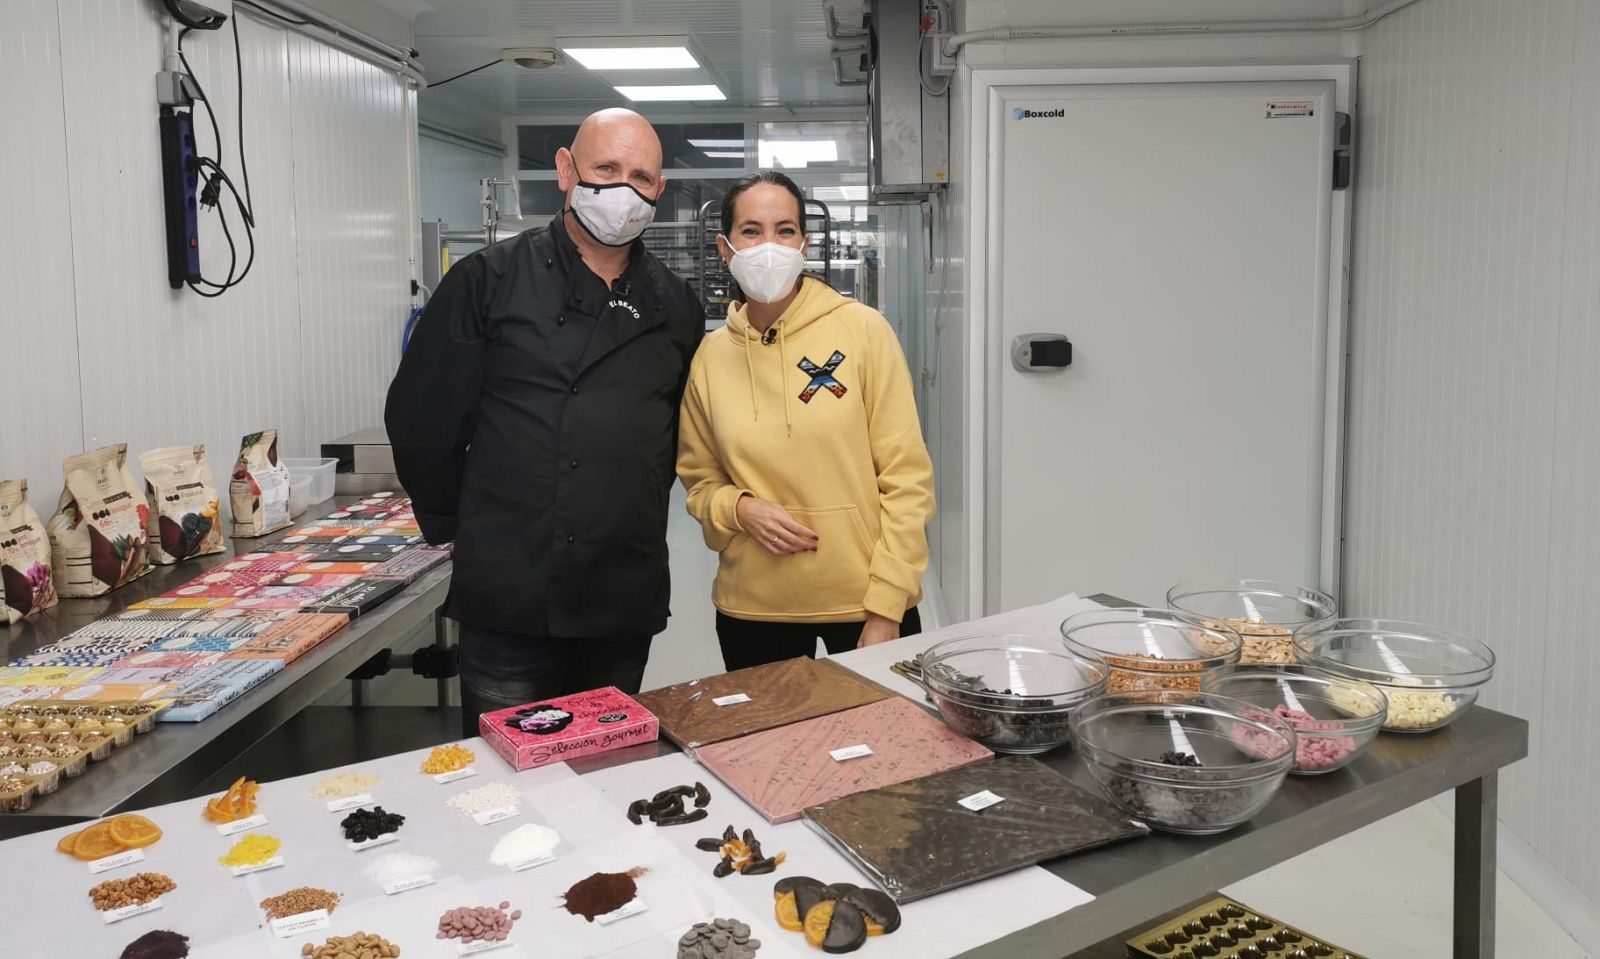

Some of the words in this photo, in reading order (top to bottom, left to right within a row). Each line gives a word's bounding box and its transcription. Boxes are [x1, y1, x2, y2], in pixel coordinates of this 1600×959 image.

[1024, 108, 1065, 118] Boxcold
[618, 299, 641, 319] BEATO
[531, 738, 599, 763] Selección
[601, 723, 649, 748] gourmet
